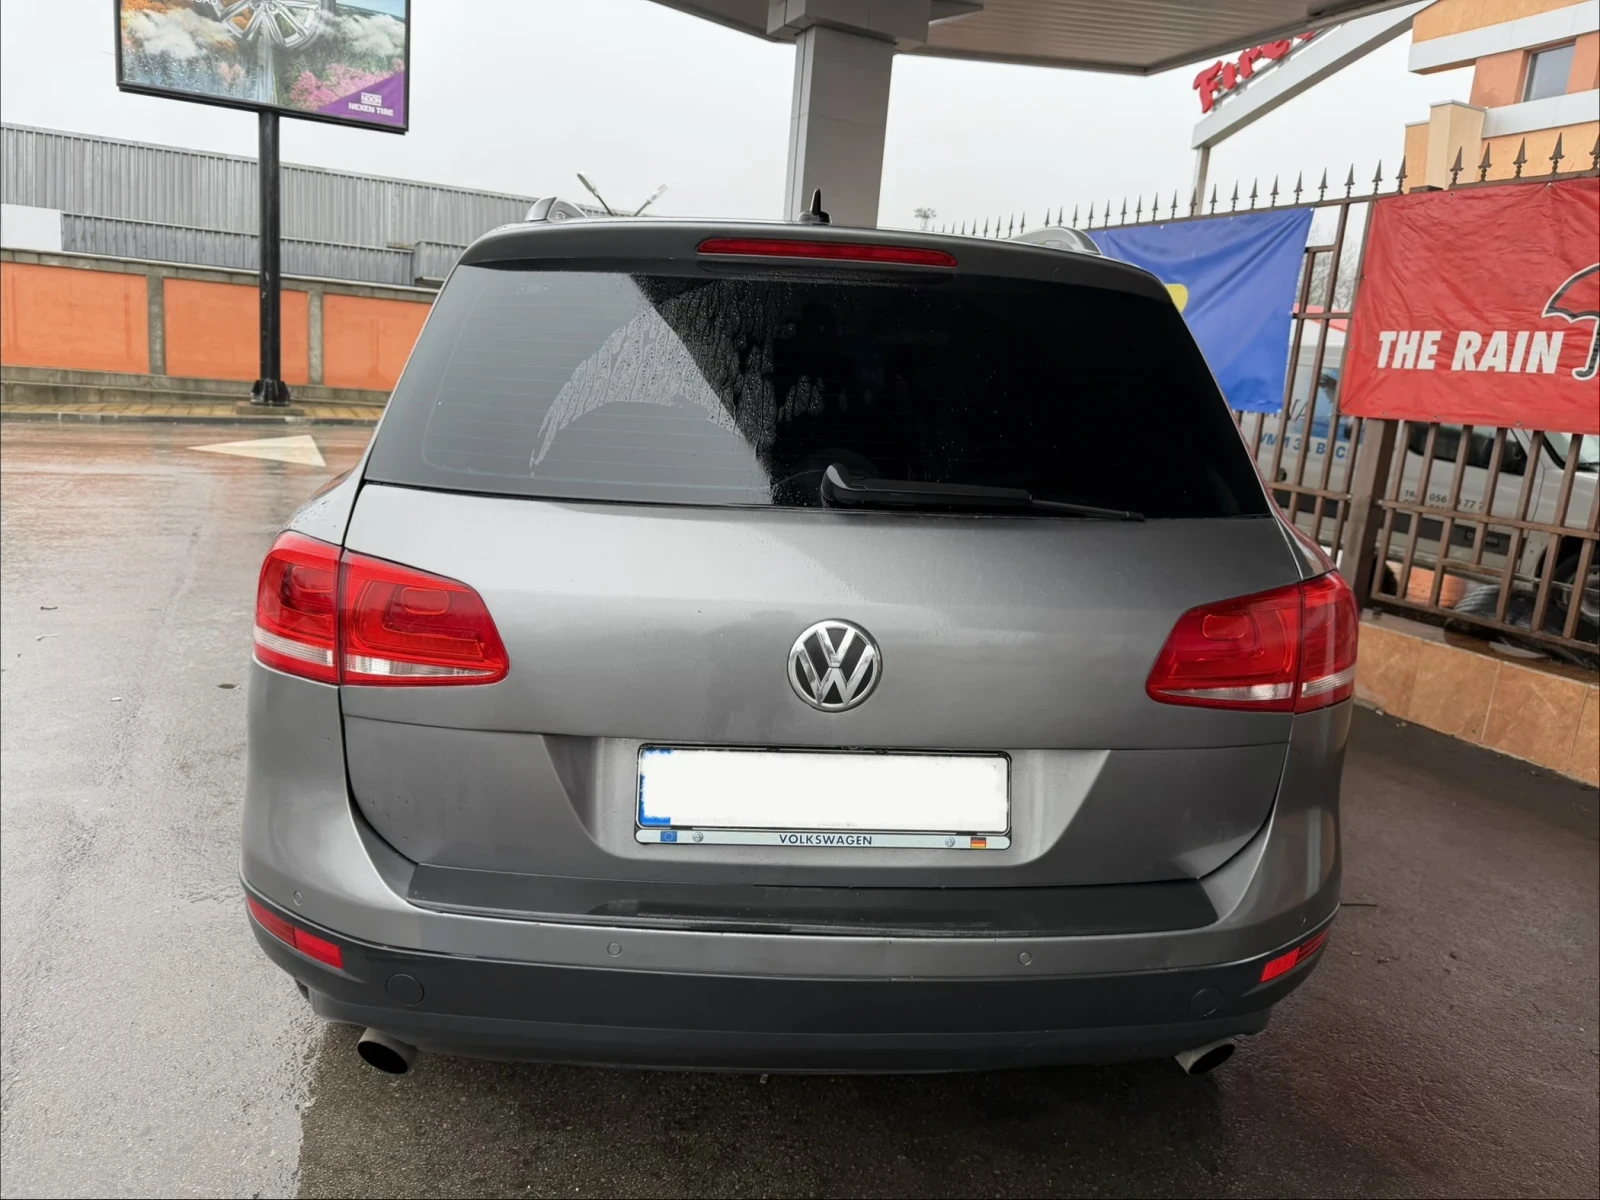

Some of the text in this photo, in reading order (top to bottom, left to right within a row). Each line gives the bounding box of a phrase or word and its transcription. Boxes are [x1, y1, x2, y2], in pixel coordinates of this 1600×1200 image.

[348, 102, 394, 117] NEXEN TIRE
[1377, 330, 1564, 374] THE RAIN
[779, 833, 872, 845] VOLKSWAGEN
